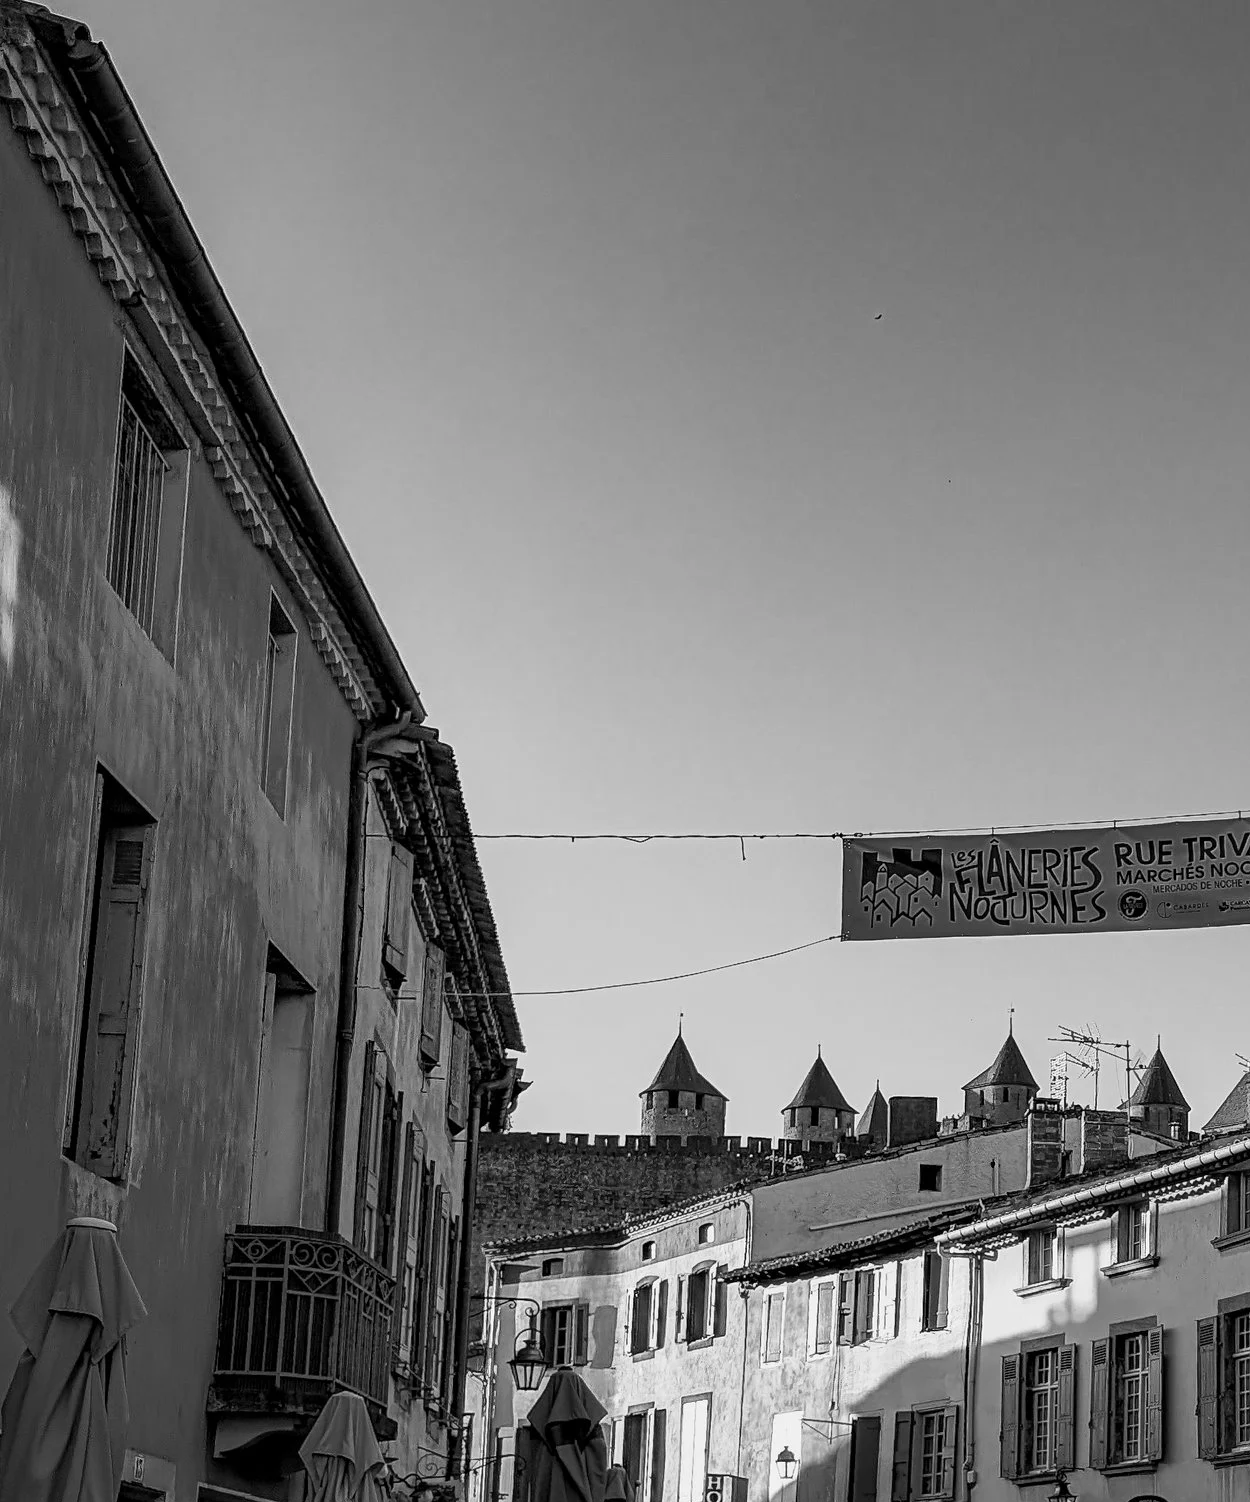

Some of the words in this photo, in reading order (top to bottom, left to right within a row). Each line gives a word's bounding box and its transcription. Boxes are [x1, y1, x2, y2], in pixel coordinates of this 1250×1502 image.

[1114, 840, 1173, 868] RUE
[1116, 864, 1205, 885] MARCHÉS
[1153, 882, 1198, 894] MERCADOS
[1200, 881, 1213, 890] DE
[1214, 878, 1243, 889] NOCHE
[949, 882, 1107, 926] NOCTURNES
